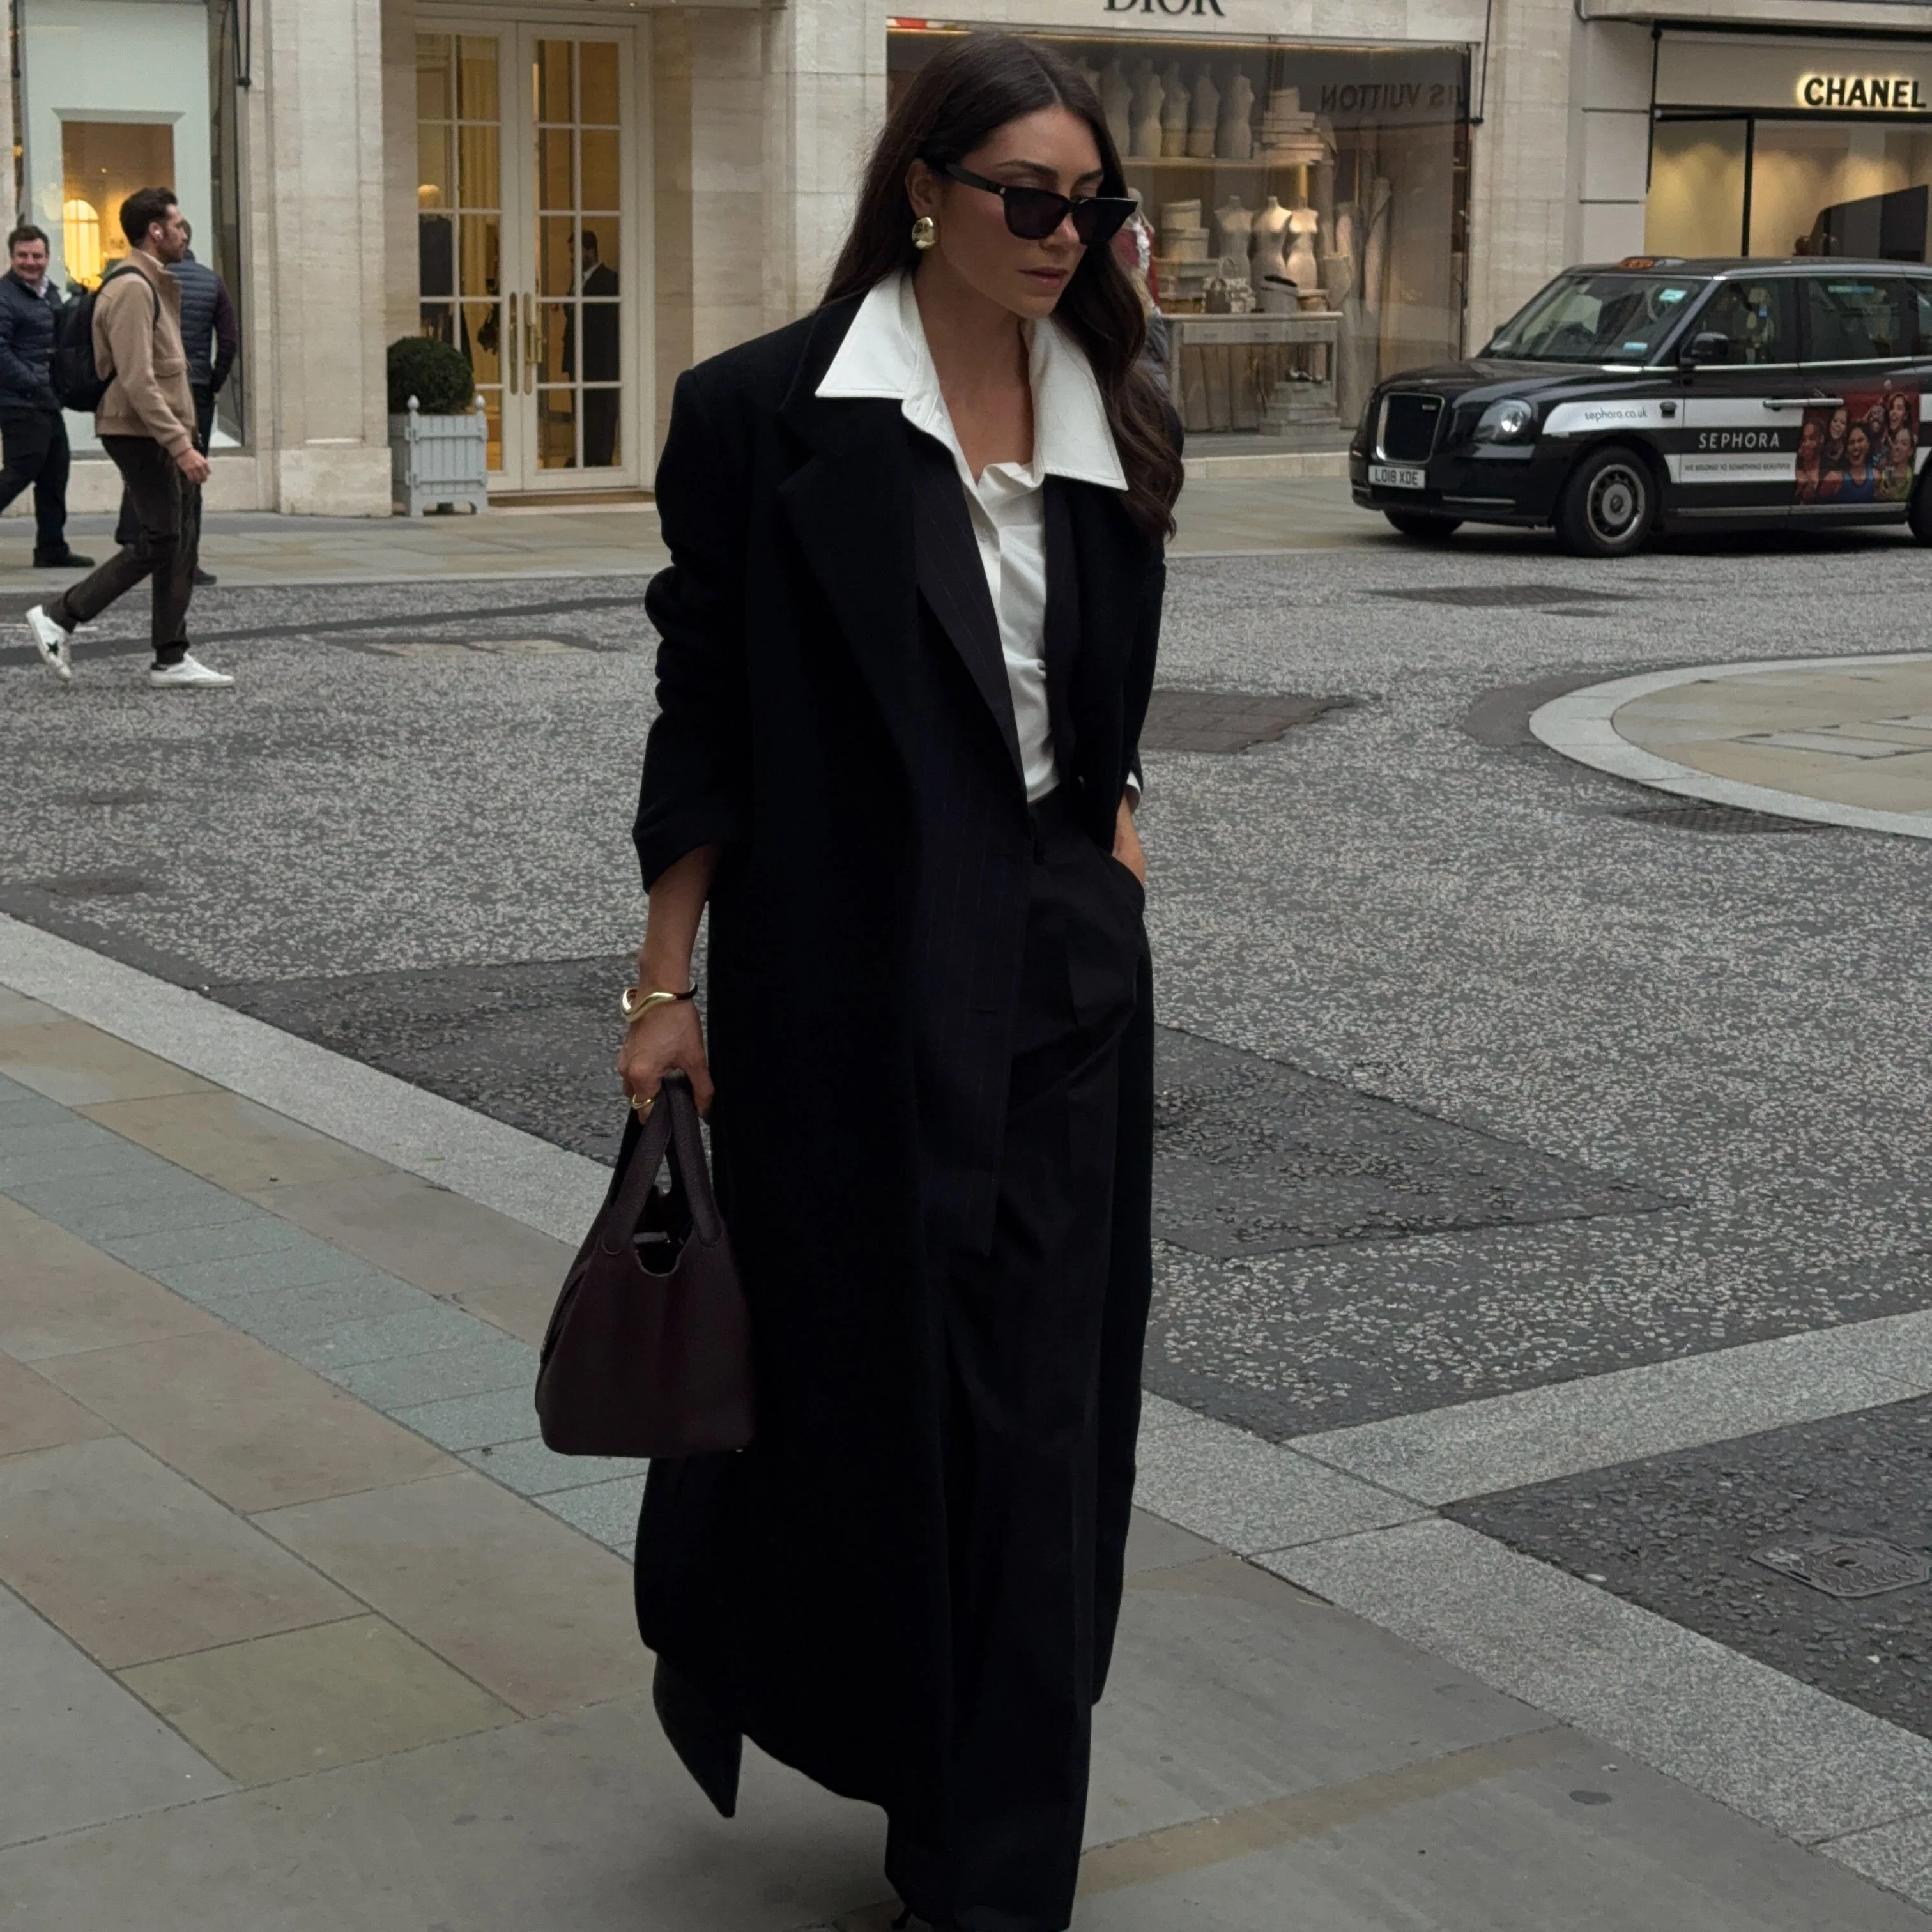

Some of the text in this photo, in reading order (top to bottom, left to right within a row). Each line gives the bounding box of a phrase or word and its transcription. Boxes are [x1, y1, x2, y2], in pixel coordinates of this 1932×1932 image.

[1804, 77, 1927, 108] CHANEL
[1584, 406, 1648, 423] sephora.co.uk
[1698, 431, 1780, 448] SEPHORA
